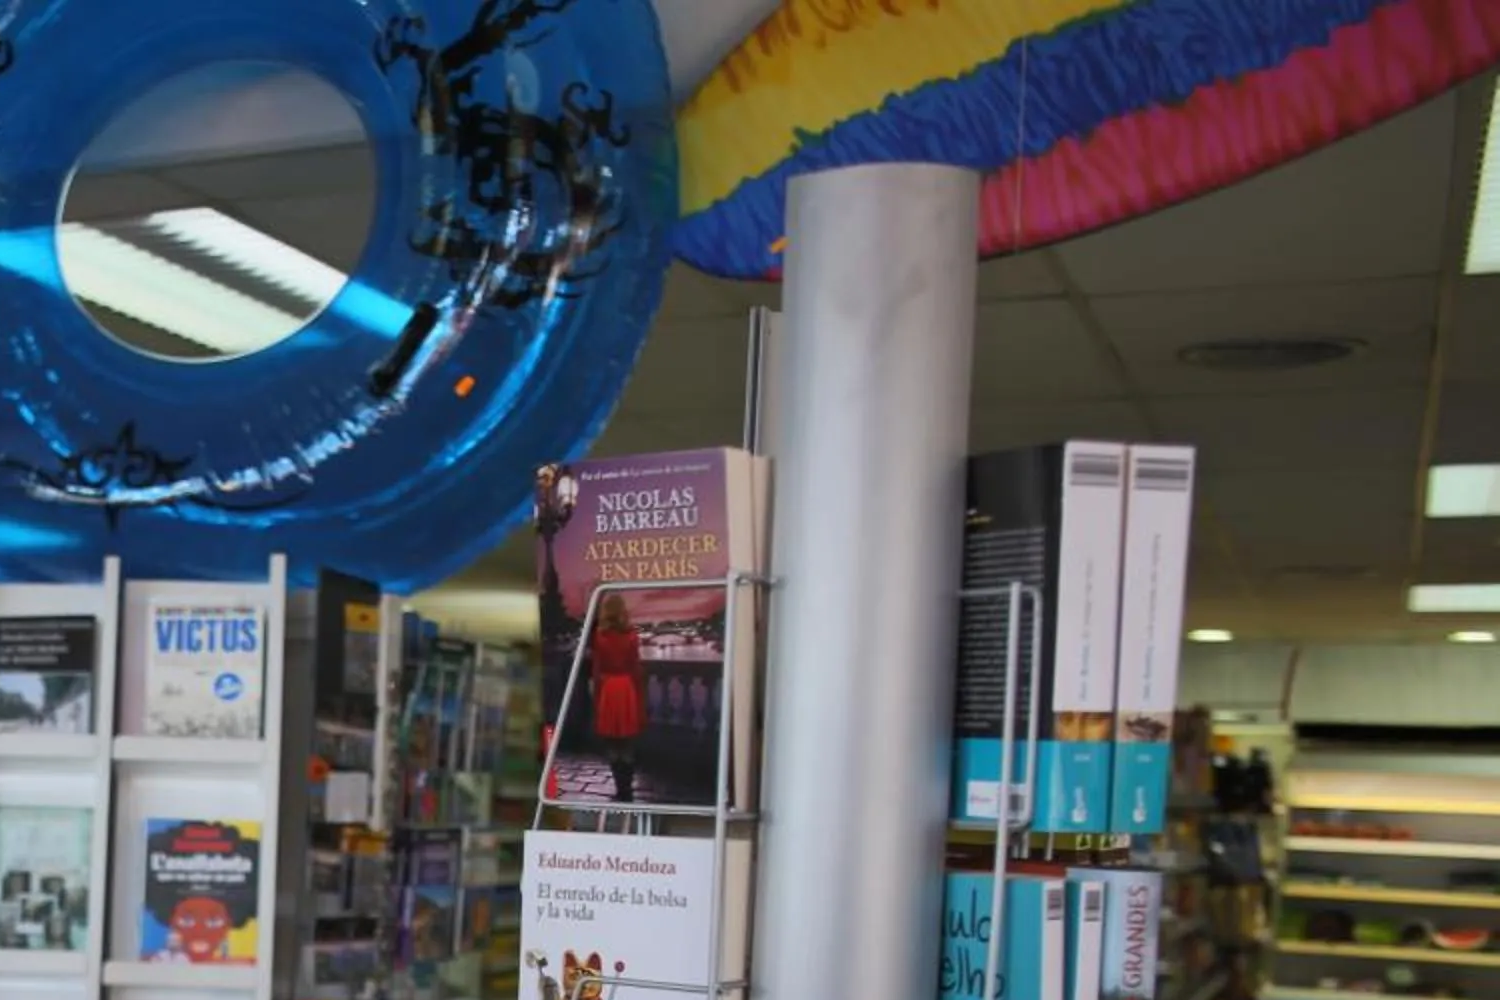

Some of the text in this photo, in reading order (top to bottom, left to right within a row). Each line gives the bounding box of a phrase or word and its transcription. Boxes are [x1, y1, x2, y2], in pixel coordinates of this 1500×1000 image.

[598, 486, 695, 512] NICOLAS
[596, 506, 699, 533] BARREAU
[585, 534, 718, 561] ATARDECER
[601, 555, 699, 581] EN PARÍS
[155, 619, 258, 653] VICTUS
[538, 852, 677, 875] Eduardo Mendoza
[537, 883, 688, 908] El enredo de la bolsa
[536, 902, 595, 922] y la vida
[1122, 885, 1149, 990] GRANDES
